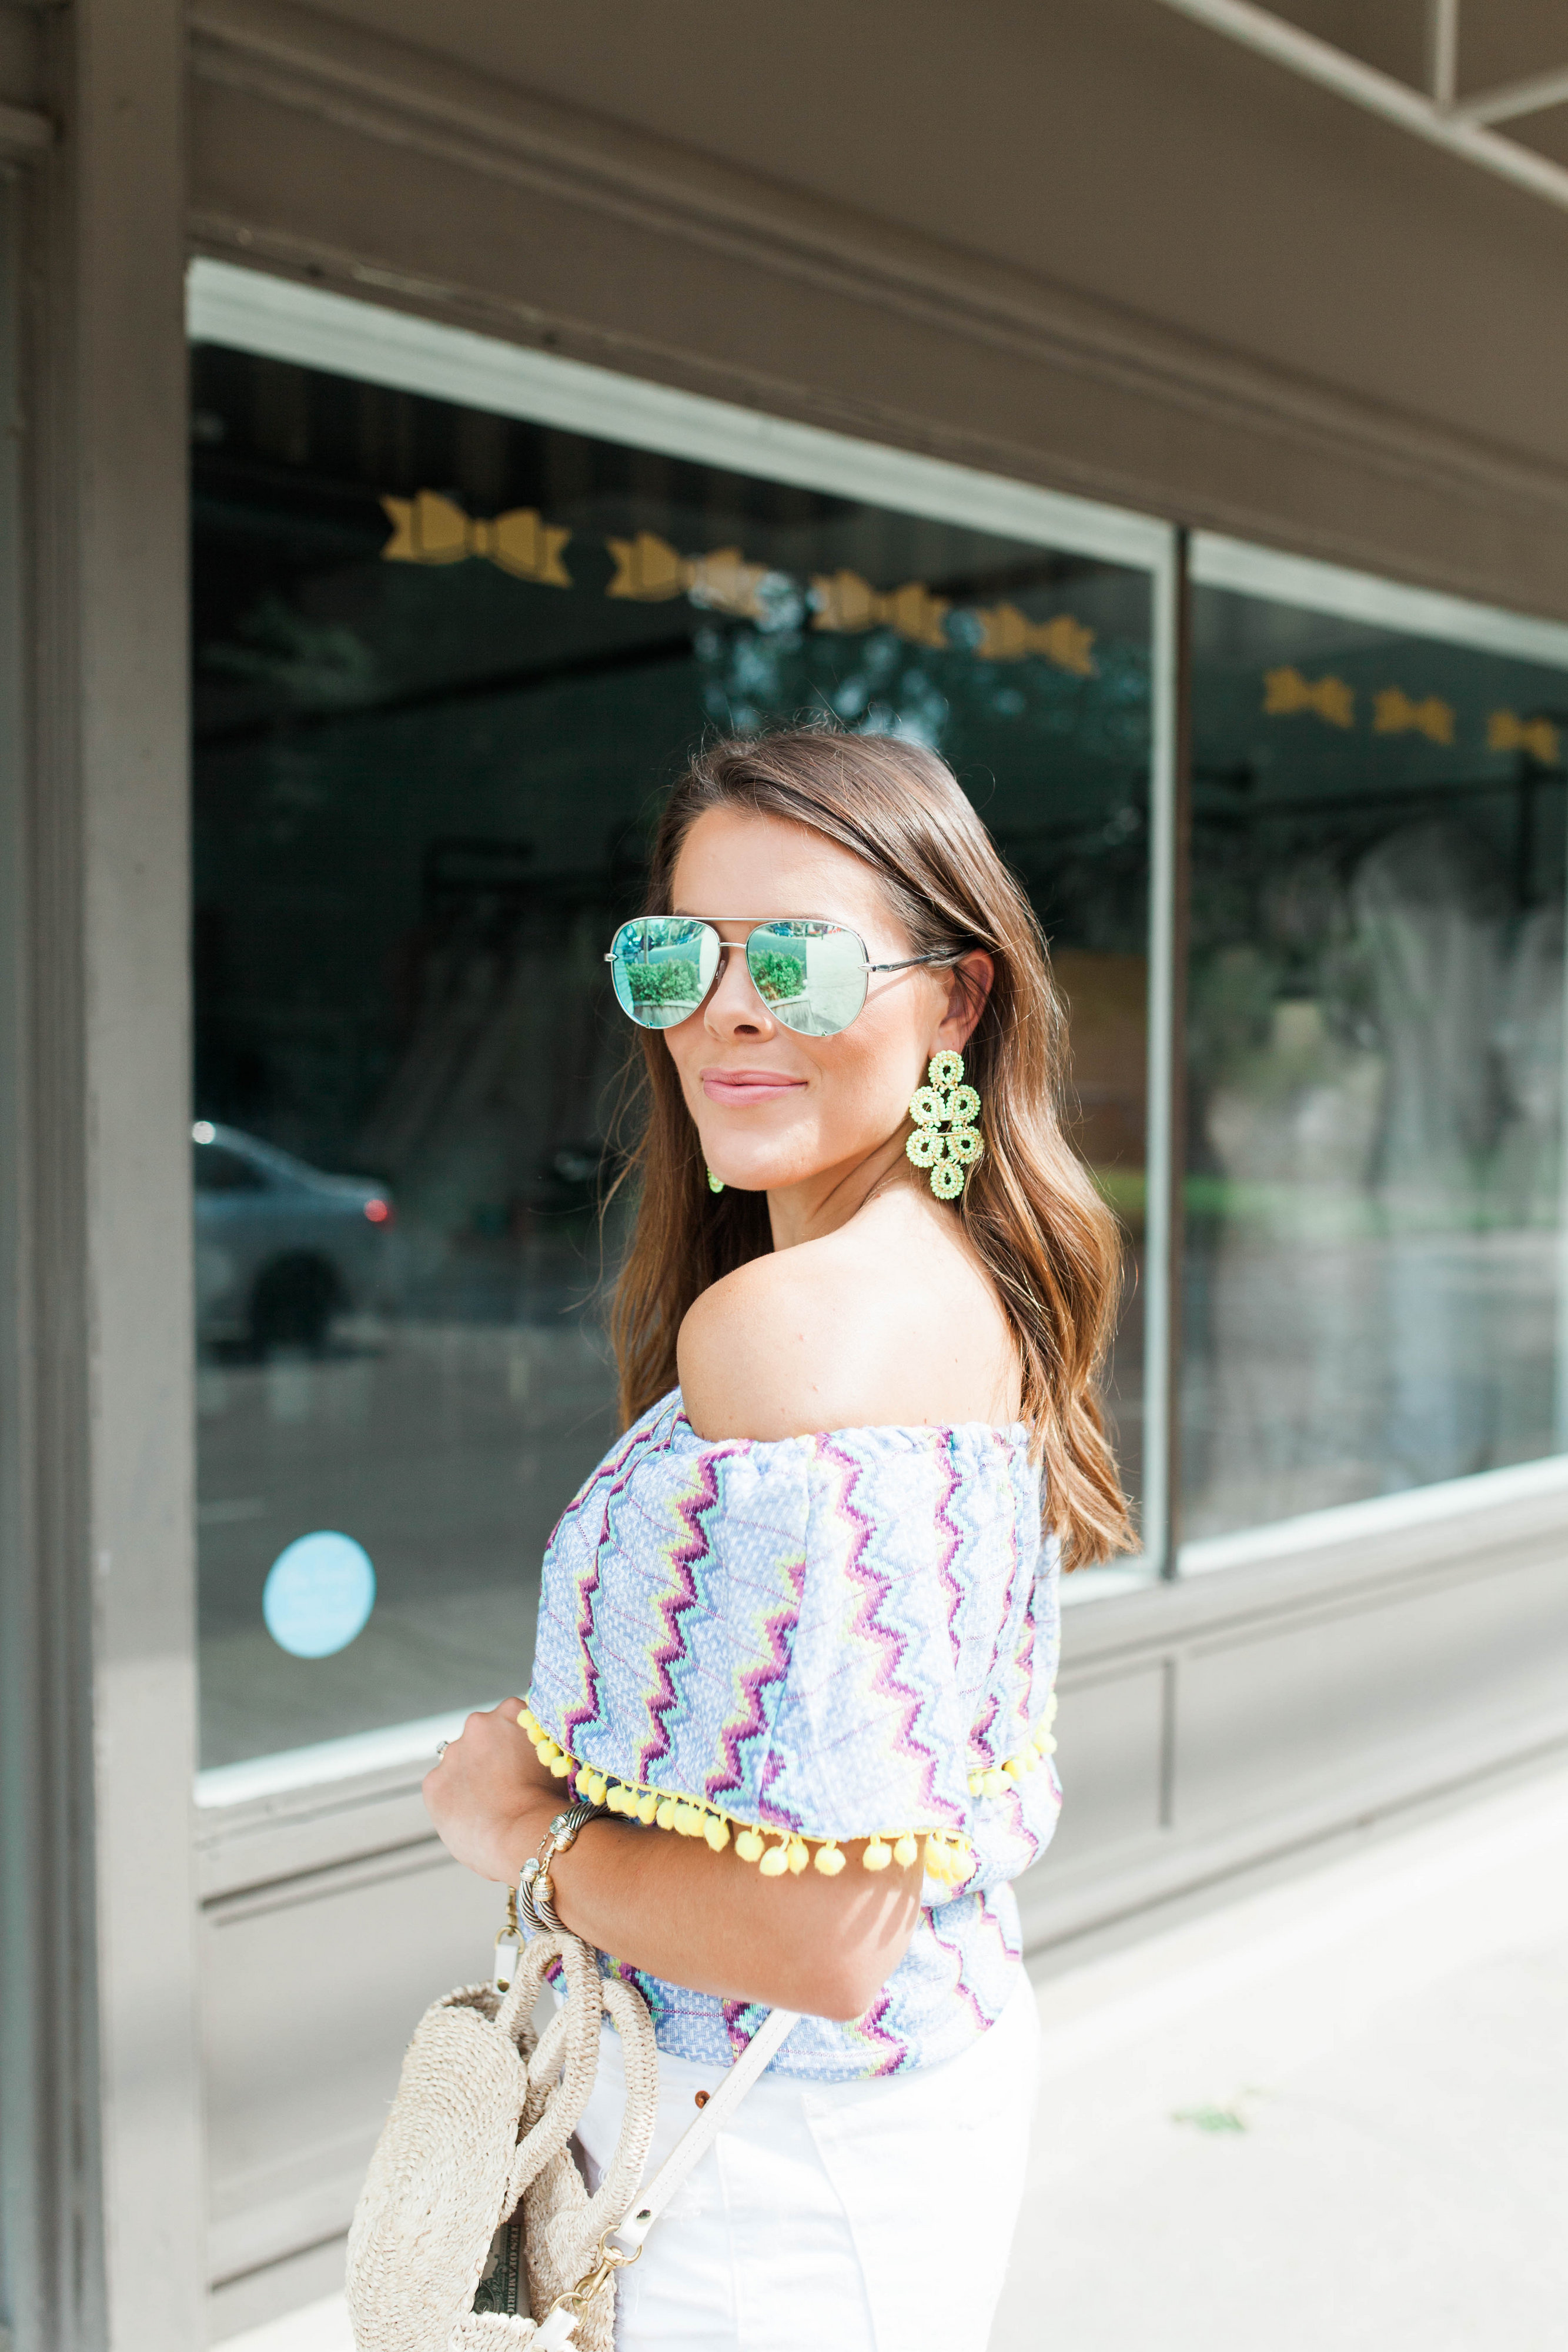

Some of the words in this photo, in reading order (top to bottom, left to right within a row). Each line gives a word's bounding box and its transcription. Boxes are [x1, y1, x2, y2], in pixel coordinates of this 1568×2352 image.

[510, 2226, 519, 2249] TES
[509, 2253, 517, 2269] OF
[507, 2271, 517, 2313] AMERIC
